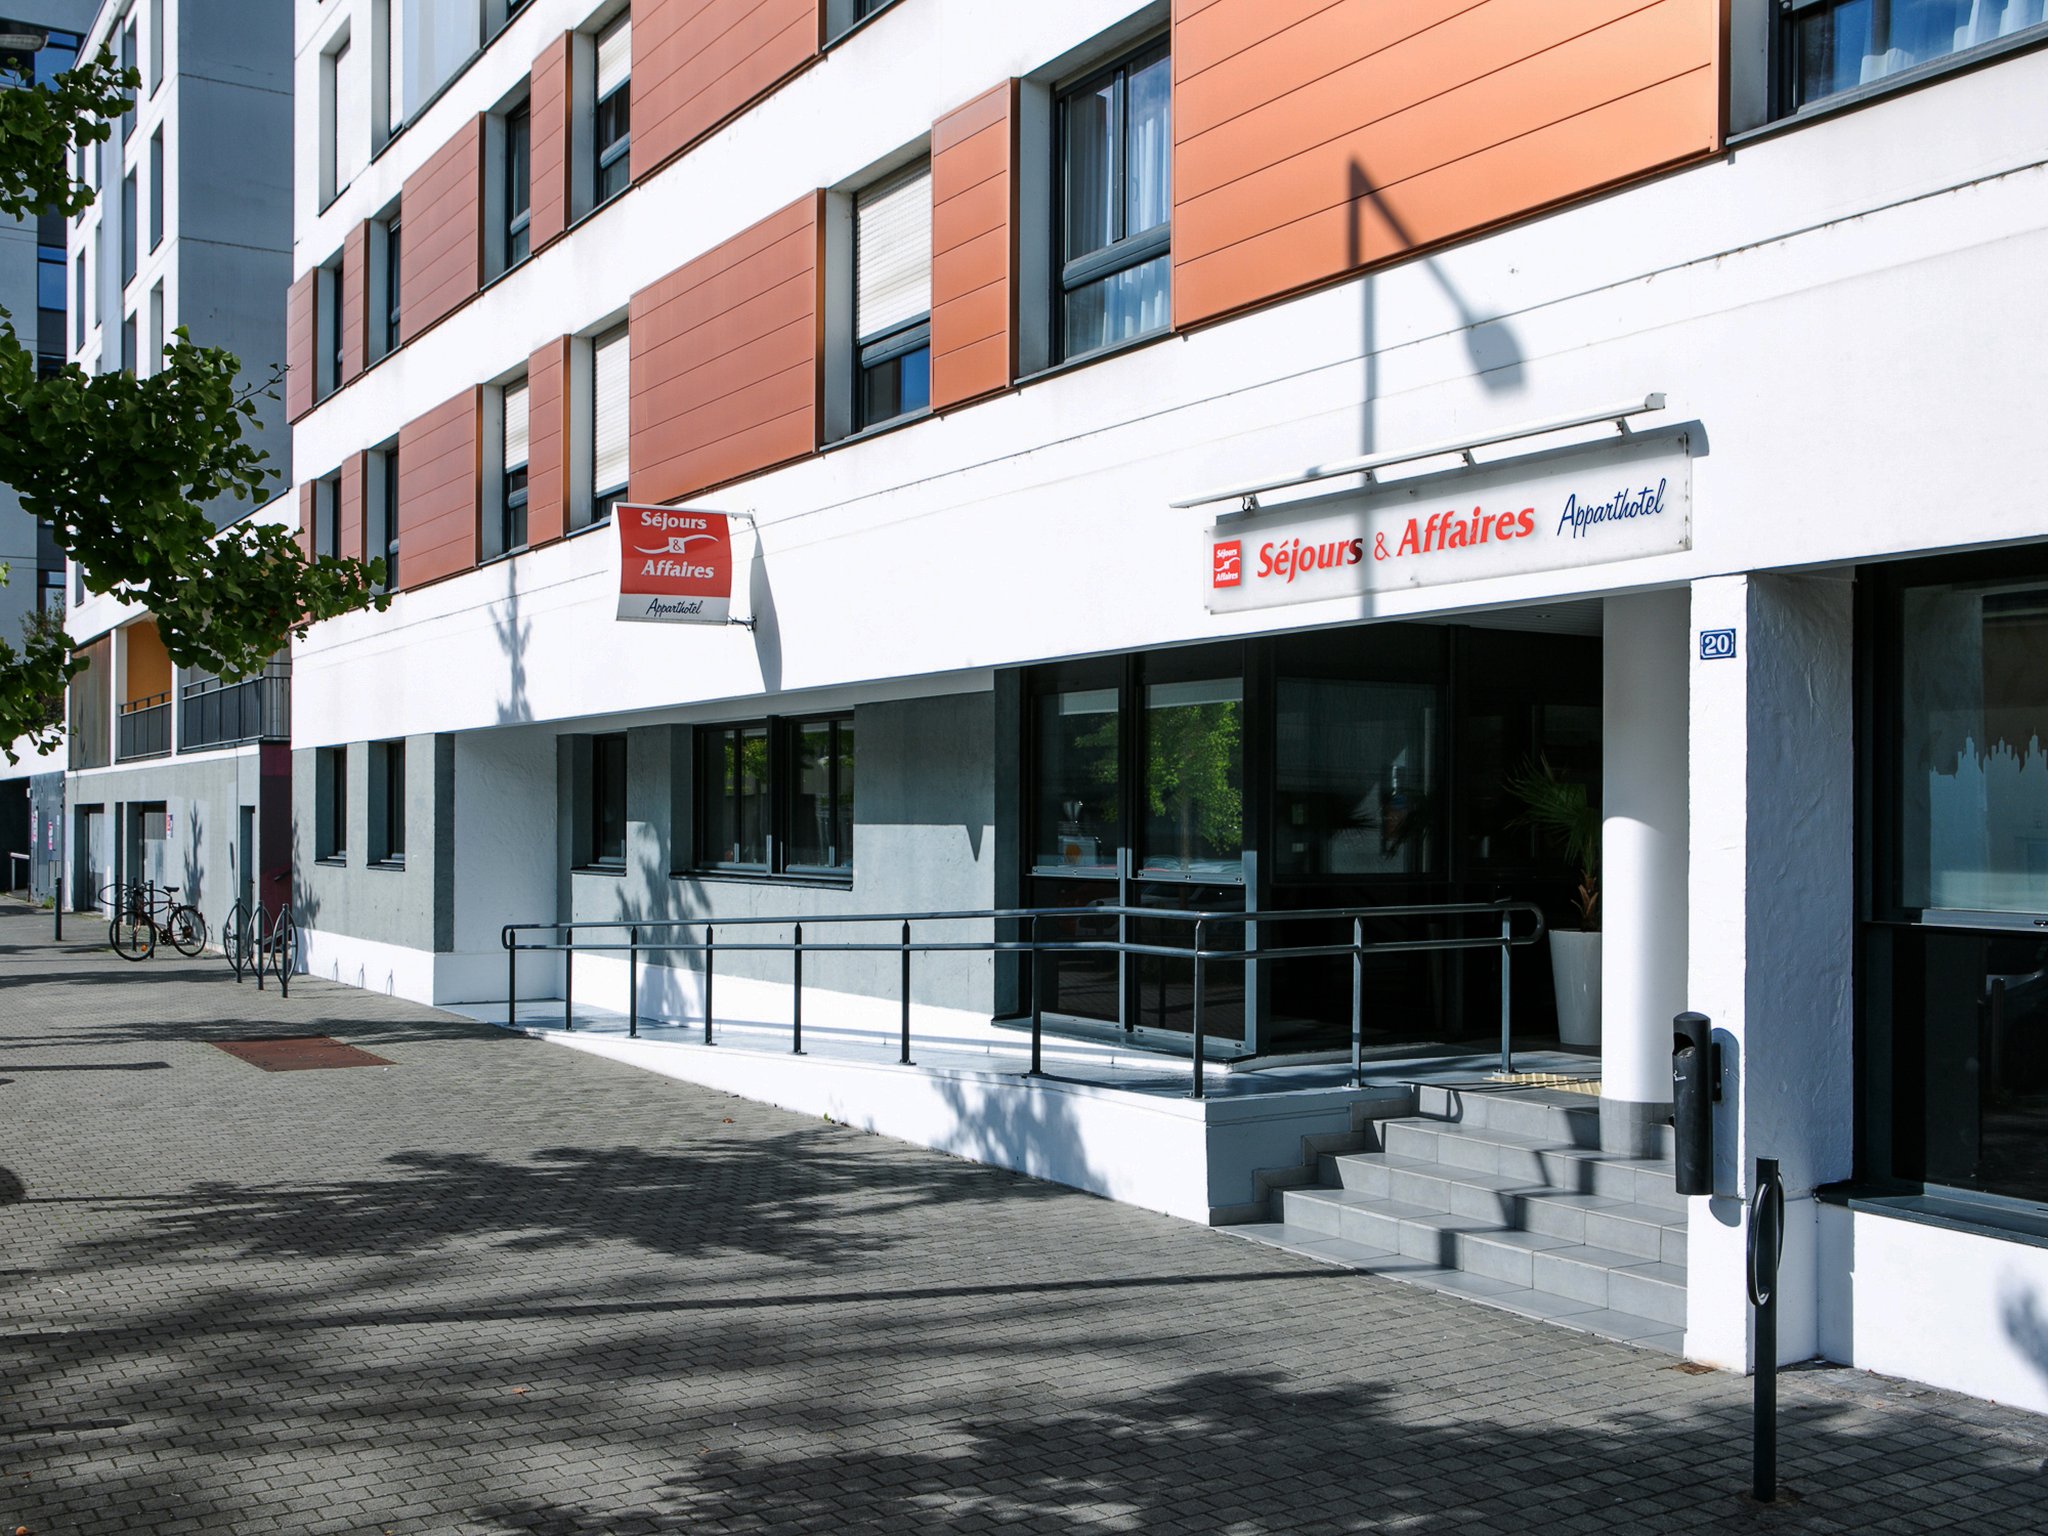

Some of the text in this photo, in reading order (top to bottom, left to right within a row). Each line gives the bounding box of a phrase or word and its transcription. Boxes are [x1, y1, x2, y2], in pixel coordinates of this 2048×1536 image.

[1557, 478, 1666, 538] Apparthotel
[641, 511, 708, 531] Séjours
[672, 539, 682, 551] &
[1257, 505, 1535, 584] Séjours & Affaires
[641, 559, 715, 579] Affaires
[645, 597, 704, 618] Apparthotel
[1704, 634, 1730, 655] 20
